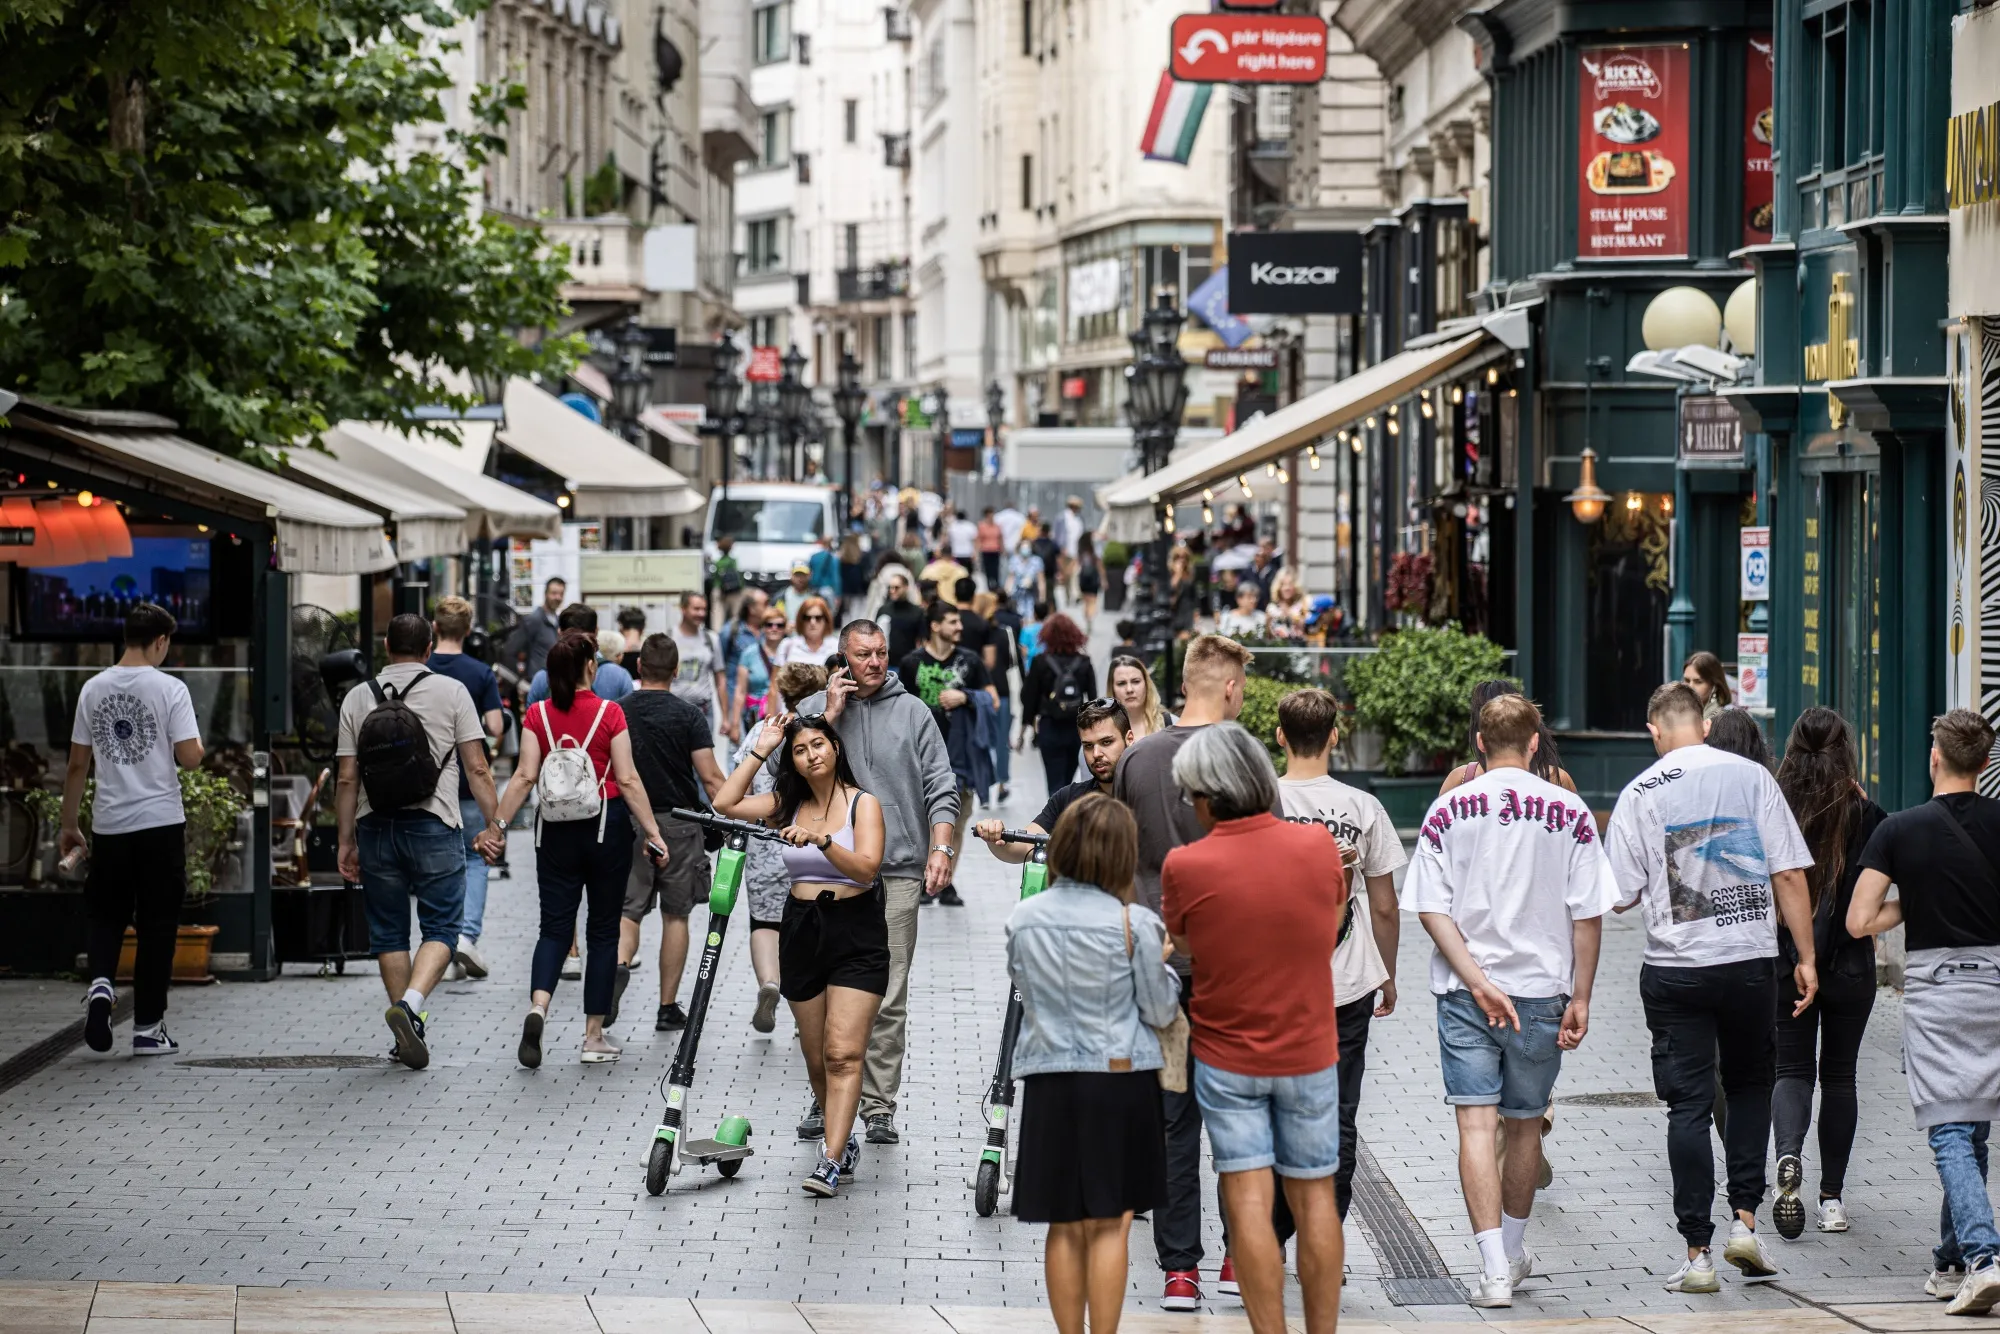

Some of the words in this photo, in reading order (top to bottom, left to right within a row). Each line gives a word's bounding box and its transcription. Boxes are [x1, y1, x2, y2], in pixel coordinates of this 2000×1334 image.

[1237, 53, 1276, 72] right
[1278, 53, 1316, 70] here
[1945, 100, 2000, 209] UNIQU
[1590, 207, 1621, 222] STEAK
[1623, 206, 1668, 220] HOUSE
[1614, 220, 1632, 232] and
[1591, 233, 1666, 248] RESTAURANT
[1250, 261, 1340, 285] Kazar
[1207, 352, 1276, 367] HUMANIC
[1695, 422, 1731, 450] MARKET
[1715, 911, 1769, 928] ODYSSEY
[699, 948, 717, 981] Lime
